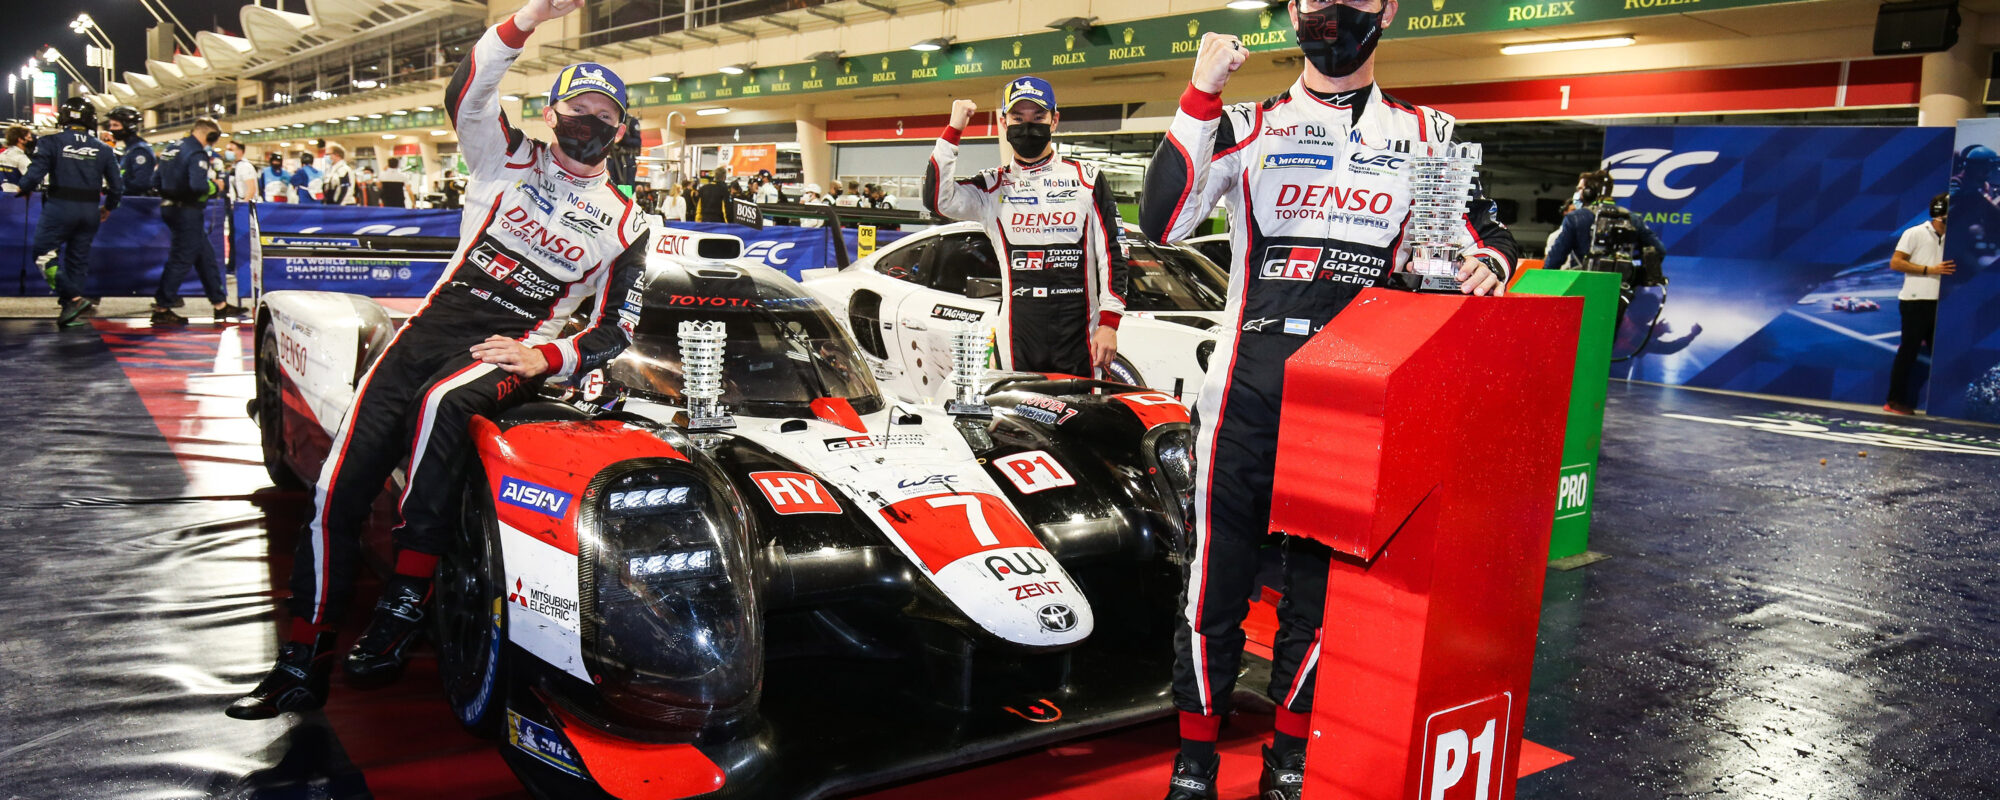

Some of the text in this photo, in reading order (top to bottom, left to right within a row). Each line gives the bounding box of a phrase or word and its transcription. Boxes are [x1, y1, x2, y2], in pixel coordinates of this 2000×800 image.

[1507, 1, 1575, 22] ROLEX
[1407, 12, 1466, 31] ROLEX
[1241, 29, 1287, 46] ROLEX
[1108, 45, 1146, 60] ROLEX
[1171, 40, 1201, 53] ROL
[1001, 58, 1032, 70] ROLEX
[1052, 52, 1086, 65] ROLEX
[872, 71, 896, 82] ROLEX
[912, 67, 937, 79] ROLEX
[954, 62, 982, 74] ROLEX
[570, 79, 618, 95] MICHELIN
[771, 83, 790, 92] ROLEX
[802, 79, 823, 89] ROLEX
[836, 75, 858, 86] ROLEX
[743, 85, 760, 94] ROLEX
[1559, 86, 1571, 110] 1
[733, 129, 740, 142] 4
[895, 120, 904, 135] 3
[1264, 125, 1299, 136] ZENT
[74, 133, 87, 142] TV
[1278, 156, 1328, 166] MICHELIN
[1350, 152, 1406, 170] WEC
[1600, 148, 1720, 200] EC
[1044, 179, 1070, 188] Mobil
[1046, 189, 1079, 198] WEC
[1275, 184, 1393, 215] DENSO
[567, 191, 601, 218] Mobil
[737, 203, 757, 219] BOSS
[563, 211, 605, 234] WEC
[1011, 211, 1077, 226] DENSO
[1275, 209, 1325, 220] TOYOTA
[498, 217, 531, 246] TOYOTA
[504, 205, 586, 262] DENSO
[1012, 226, 1041, 234] TOYOTA
[656, 234, 690, 256] ZENT
[743, 240, 796, 265] EC
[472, 250, 512, 280] GR
[1012, 257, 1042, 269] GR
[1327, 248, 1386, 267] TOYOTA
[286, 265, 370, 273] CHAMPIONSHIP
[371, 267, 391, 279] FIA
[1262, 258, 1315, 279] GR
[1322, 260, 1381, 277] GAZOO
[511, 273, 555, 298] GAZOO
[1317, 270, 1376, 288] Racing
[280, 331, 307, 377] DENSO
[1021, 396, 1067, 414] TOYOTA
[1014, 404, 1058, 425] HYBRID
[1057, 407, 1079, 425] 7
[826, 439, 874, 451] GR
[1007, 455, 1062, 485] P1
[897, 474, 959, 489] WEC
[502, 481, 566, 514] AISIN
[759, 476, 825, 505] HY
[1556, 471, 1588, 511] PRO
[928, 494, 1000, 548] 7
[1007, 580, 1066, 602] ZENT
[530, 588, 578, 612] MITSUBISHI
[529, 599, 570, 622] ELECTRIC
[1430, 718, 1497, 800] P1
